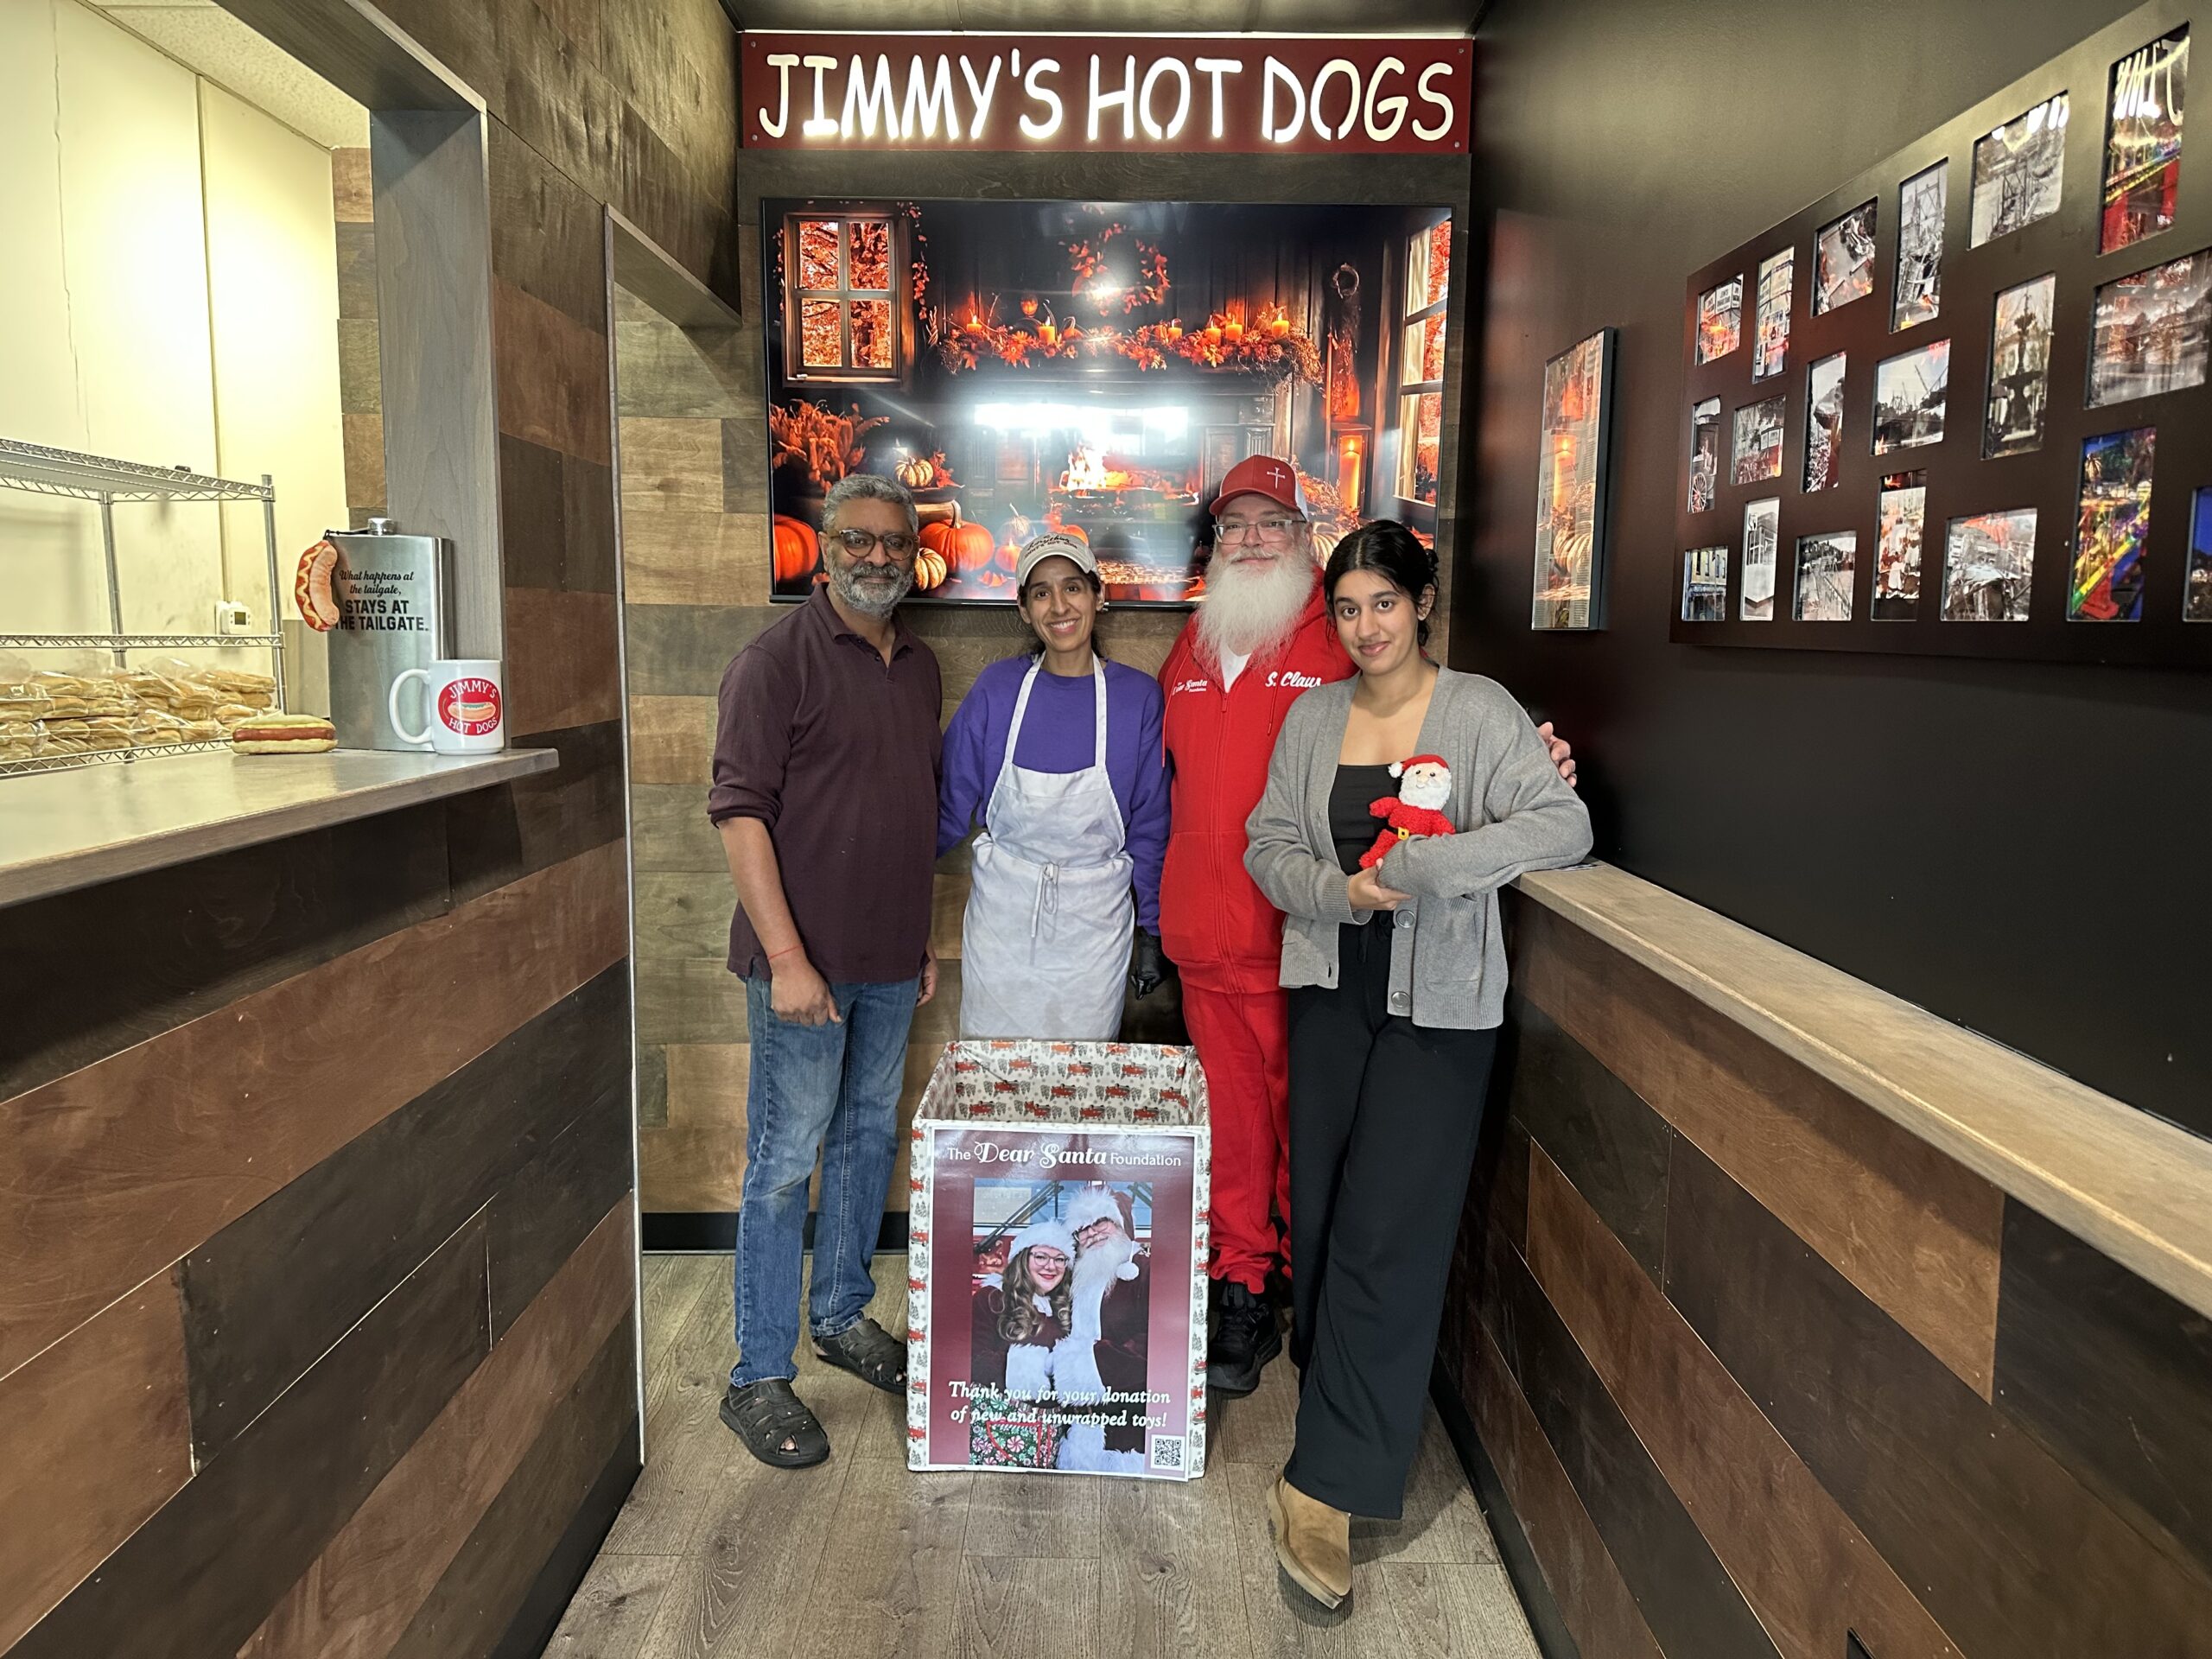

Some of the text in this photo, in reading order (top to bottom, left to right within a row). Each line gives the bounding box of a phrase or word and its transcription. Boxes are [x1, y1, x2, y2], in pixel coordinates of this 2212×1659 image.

[759, 48, 1454, 143] JIMMY'S HOT DOGS
[339, 570, 415, 585] What happens at
[349, 584, 402, 598] the tailgate,
[346, 600, 410, 614] STAYS AT
[359, 615, 429, 632] TAILGATE.
[1265, 671, 1278, 688] S.
[448, 680, 497, 699] JIMMY'S
[448, 716, 498, 734] HOT DOGS
[946, 1141, 1182, 1169] The Dear Santa Foundation
[949, 1380, 1172, 1407] Thank you for your donation
[950, 1405, 1168, 1430] of new and unwrapped toys!
